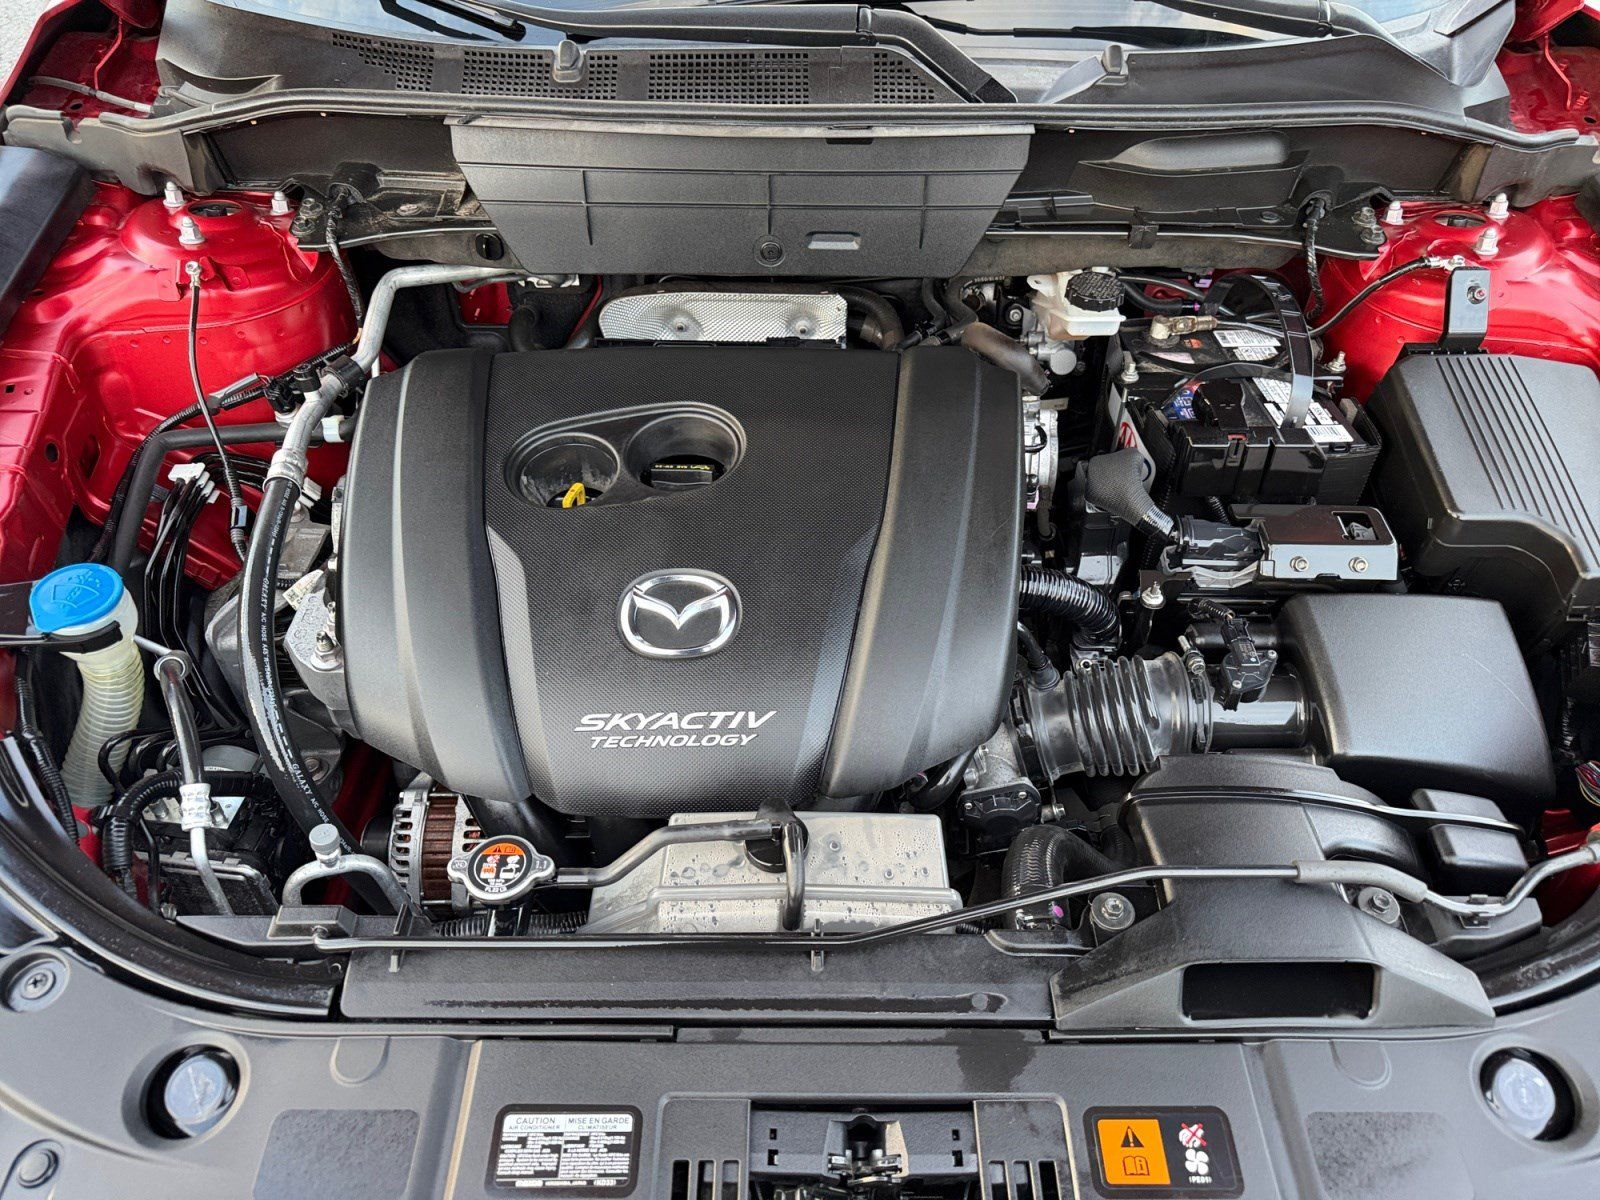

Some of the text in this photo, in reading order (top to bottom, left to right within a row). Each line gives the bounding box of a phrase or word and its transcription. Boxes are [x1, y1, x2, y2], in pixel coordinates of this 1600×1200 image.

[261, 578, 270, 611] GALAXY
[573, 711, 778, 732] SKYACTIV
[590, 734, 758, 749] TECHNOLOGY
[292, 763, 313, 795] GALAXY
[310, 798, 320, 808] A/C
